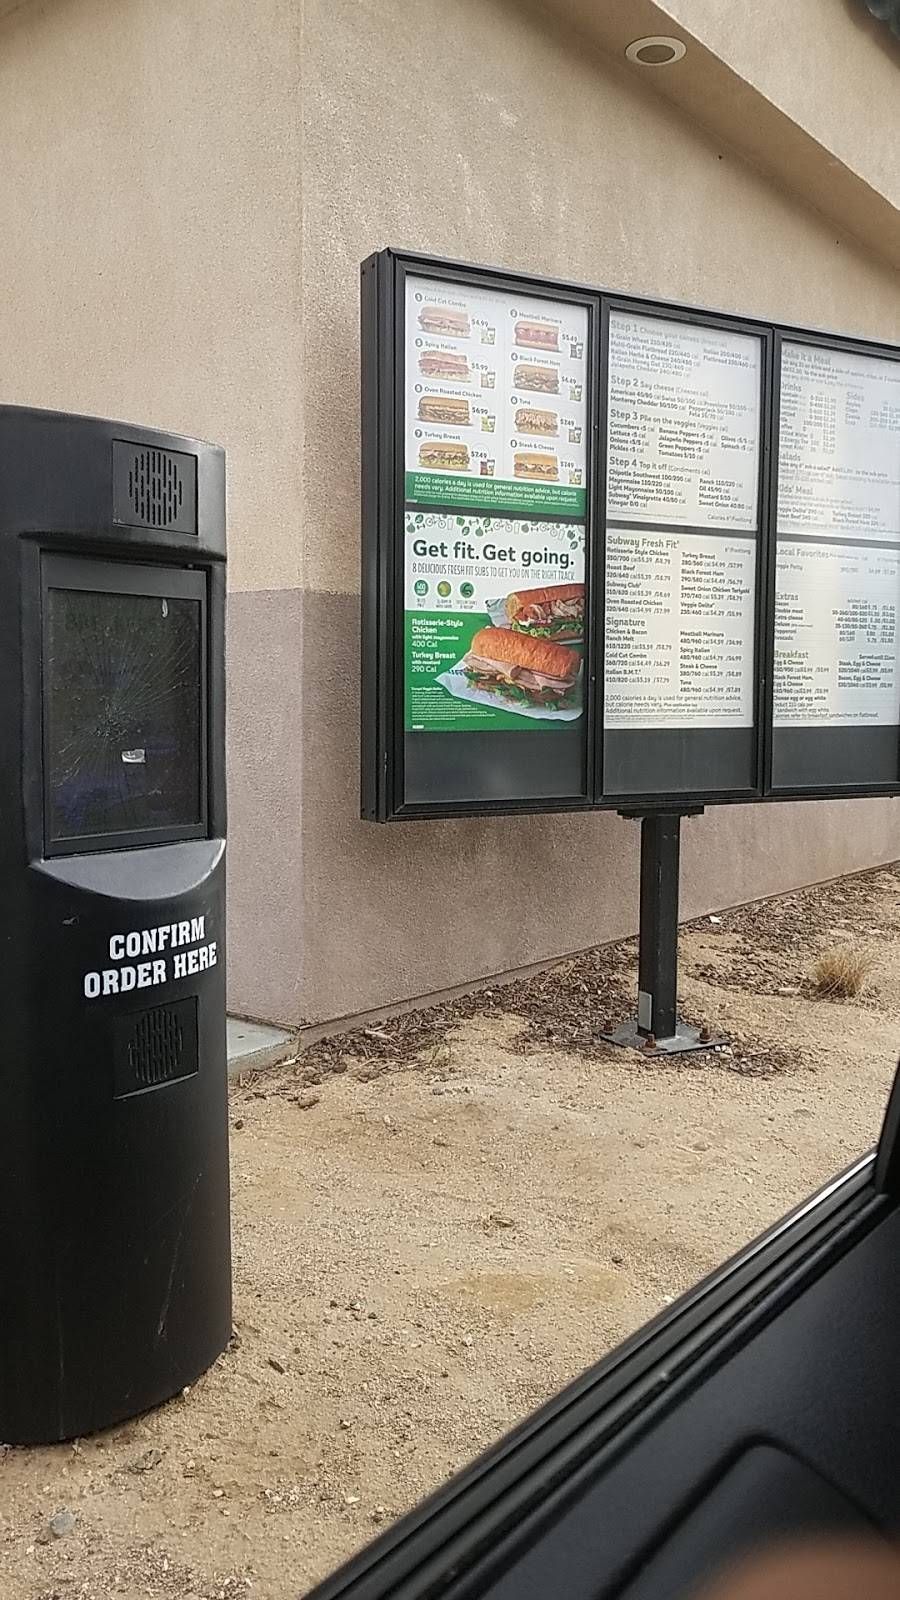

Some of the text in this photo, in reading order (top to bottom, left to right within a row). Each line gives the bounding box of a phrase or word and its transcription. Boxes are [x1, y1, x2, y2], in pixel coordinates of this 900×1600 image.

[611, 321, 631, 333] Step
[611, 376, 631, 387] Step
[611, 409, 630, 421] Step
[632, 412, 638, 420] 3
[674, 420, 696, 429] veggies
[610, 422, 639, 430] Cucumbers
[610, 429, 630, 437] Lettuce
[610, 457, 630, 468] Step
[639, 462, 650, 470] Top
[609, 469, 632, 478] Chipotle
[432, 477, 452, 485] calories
[457, 480, 466, 488] day
[494, 483, 512, 492] general
[445, 486, 472, 494] Additional
[473, 488, 494, 496] nutrition
[495, 489, 523, 498] information
[524, 492, 545, 500] available
[609, 500, 629, 508] Vinegar
[608, 536, 664, 548] Subway Fresh
[413, 540, 574, 569] Get fit. Get going.
[412, 564, 416, 572] 8
[418, 563, 446, 574] DELICIOUS
[448, 564, 464, 575] FRESH
[475, 566, 489, 576] SUBS
[491, 567, 497, 577] TO
[498, 568, 508, 577] GET
[509, 568, 520, 578] YOU
[521, 569, 530, 578] ON
[531, 569, 541, 579] THE
[541, 569, 557, 580] RIGHT
[558, 570, 574, 581] TRACK
[412, 619, 463, 627] Rotisserie-Style
[606, 617, 645, 627] Signature
[412, 626, 437, 634] Chicken
[110, 916, 205, 960] CONFIRM
[84, 942, 216, 998] ORDER HERE
